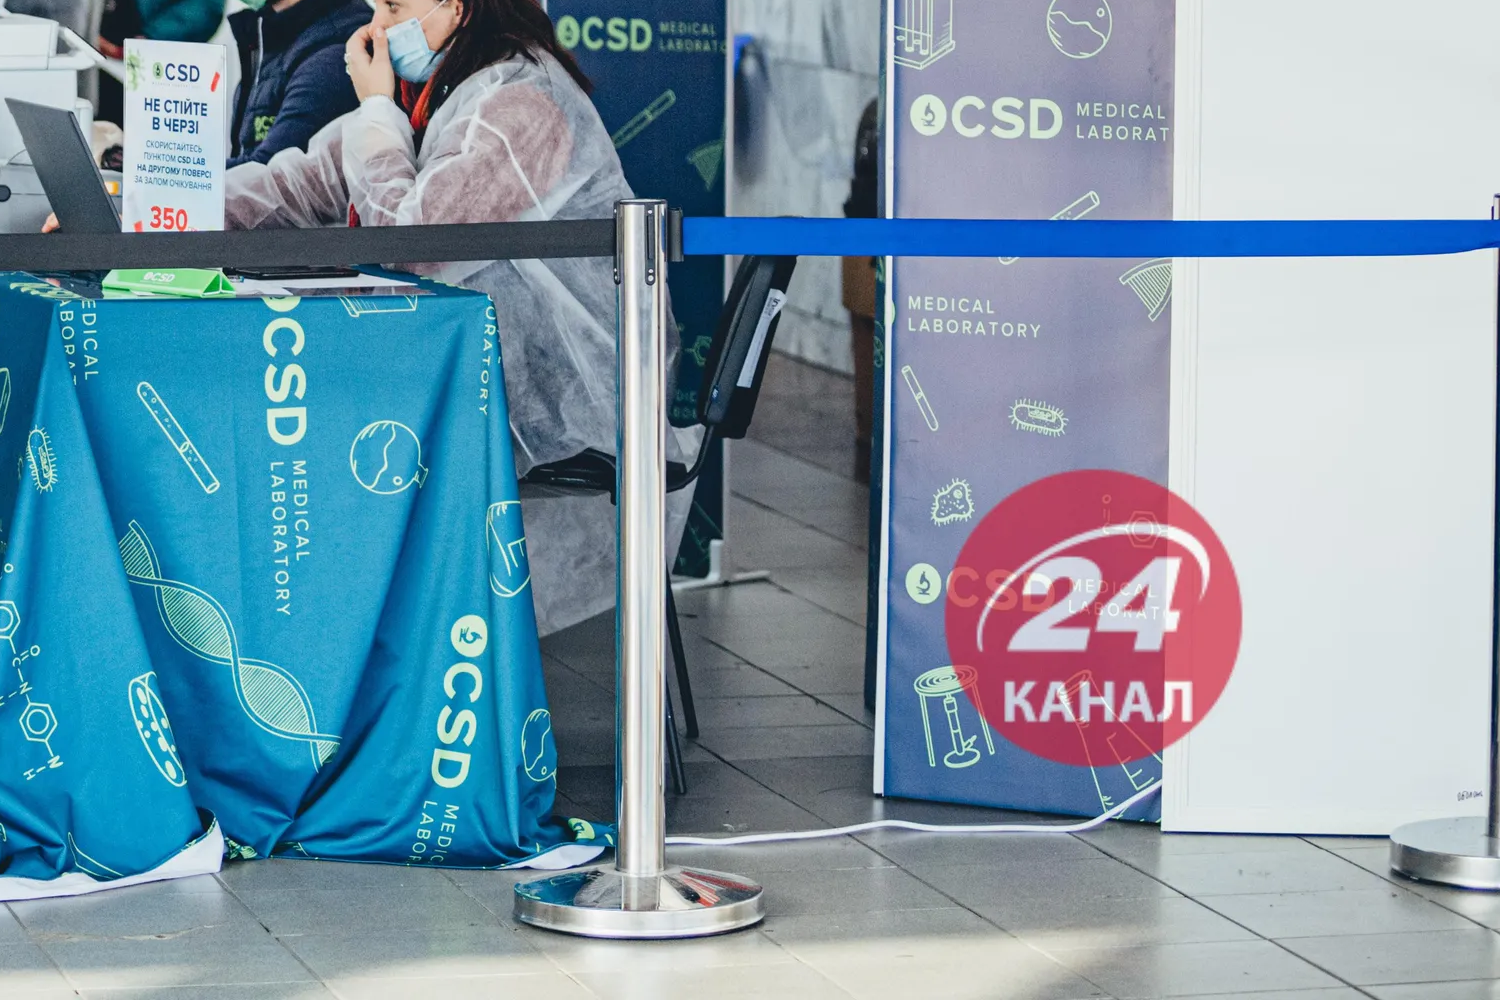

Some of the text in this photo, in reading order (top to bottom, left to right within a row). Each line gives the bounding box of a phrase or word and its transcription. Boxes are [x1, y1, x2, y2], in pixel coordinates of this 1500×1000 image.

[582, 16, 653, 51] CSD
[658, 21, 717, 36] MEDICAL
[165, 63, 200, 82] CSD
[144, 97, 208, 117] НЕ СТІЙТЕ
[1076, 102, 1166, 120] MEDICAL
[152, 116, 199, 135] В ЧЕРЗІ
[952, 95, 1063, 140] CSD
[1076, 125, 1170, 142] LABORAT
[145, 139, 203, 154] СКОРИСТАЙТЕСЬ
[143, 151, 206, 166] ПУНКТОМ CSD LAB
[137, 163, 212, 179] НА ДРУГОМУ ПОВЕРСІ
[134, 175, 212, 191] ЗА ЗАЛОМ ОЧІКУВАННЯ
[150, 205, 188, 233] 350
[908, 295, 995, 315] MEDICAL
[908, 318, 1041, 339] LABORATORY
[81, 299, 100, 381] EDICAL
[263, 317, 308, 446] CSD
[292, 459, 311, 561] MEDICAL
[270, 461, 291, 616] LABORATORY
[431, 660, 484, 788] CSD
